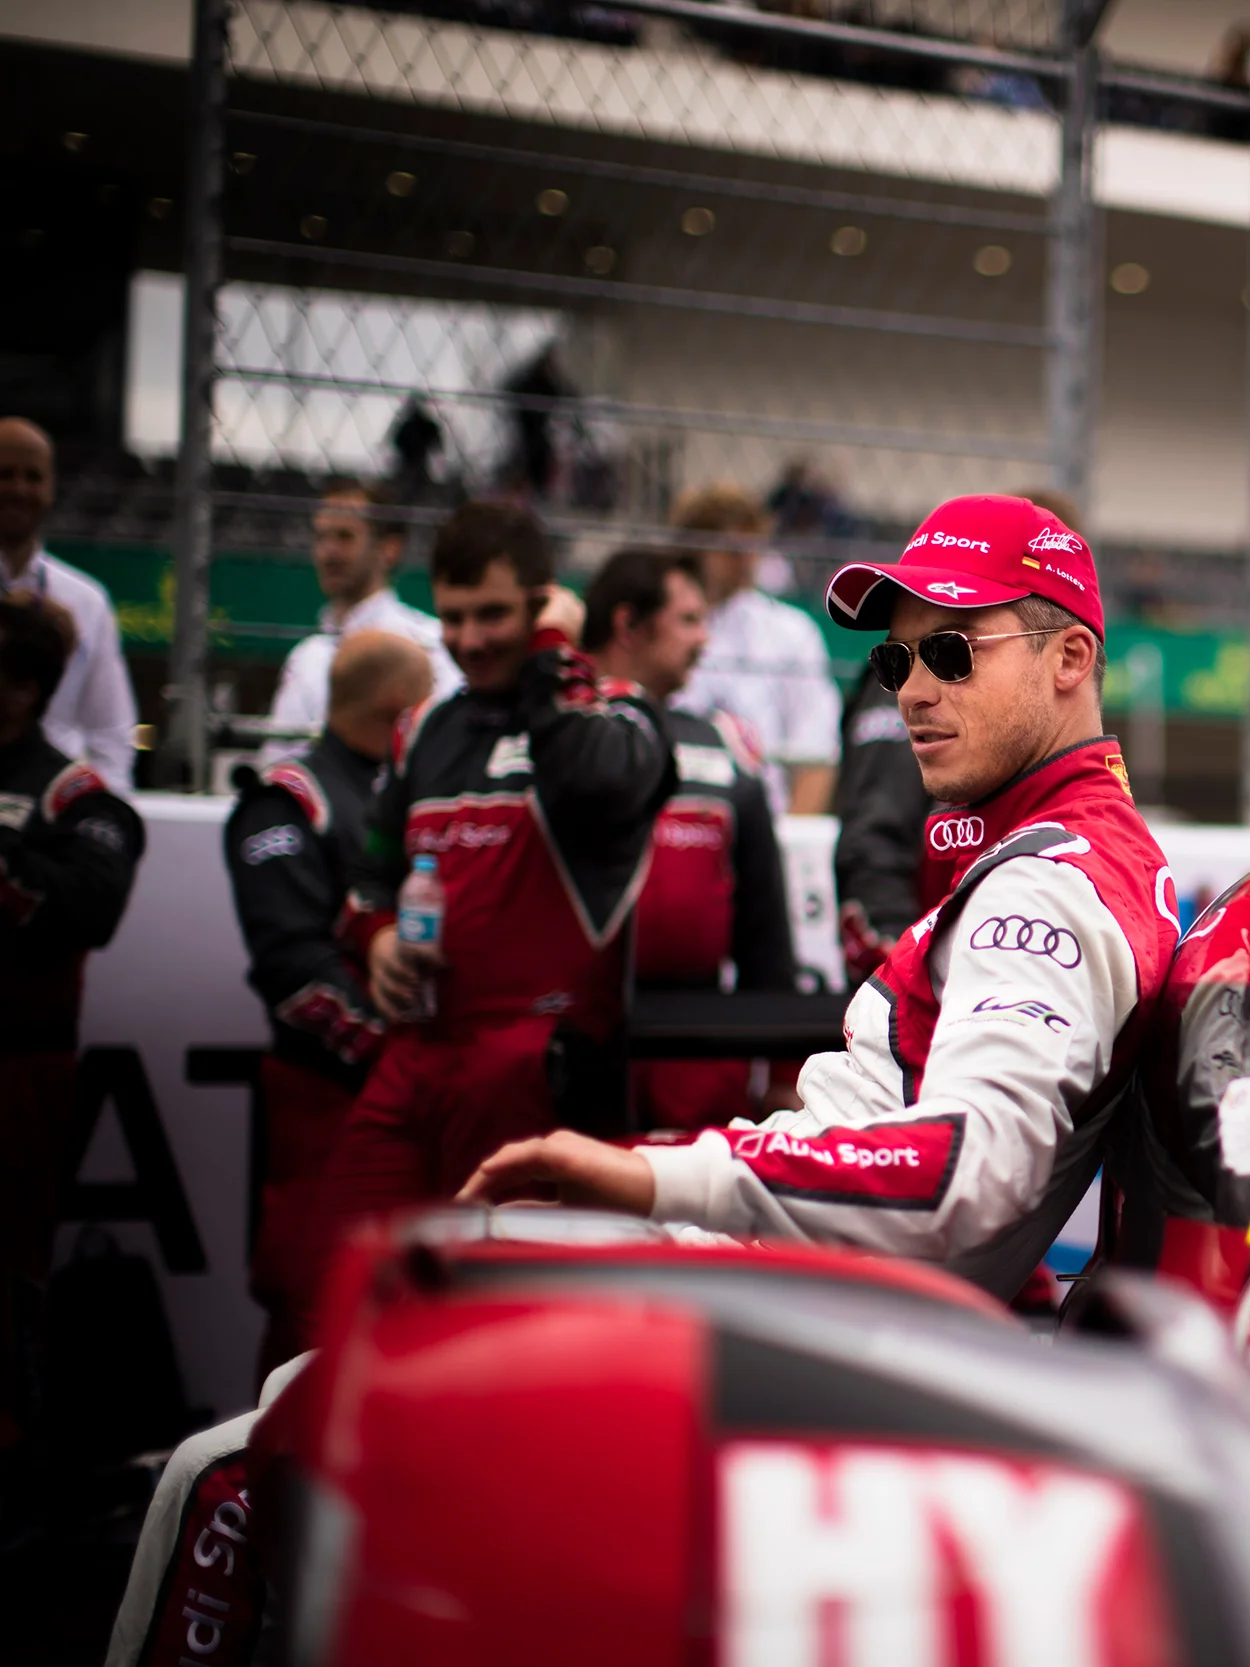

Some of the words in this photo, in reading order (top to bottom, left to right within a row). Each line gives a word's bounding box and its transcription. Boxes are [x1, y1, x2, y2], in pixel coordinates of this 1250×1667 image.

[904, 533, 929, 553] udi
[931, 531, 991, 554] Sport
[1045, 563, 1056, 573] A.
[972, 996, 1072, 1034] WEC
[837, 1143, 920, 1168] Sport
